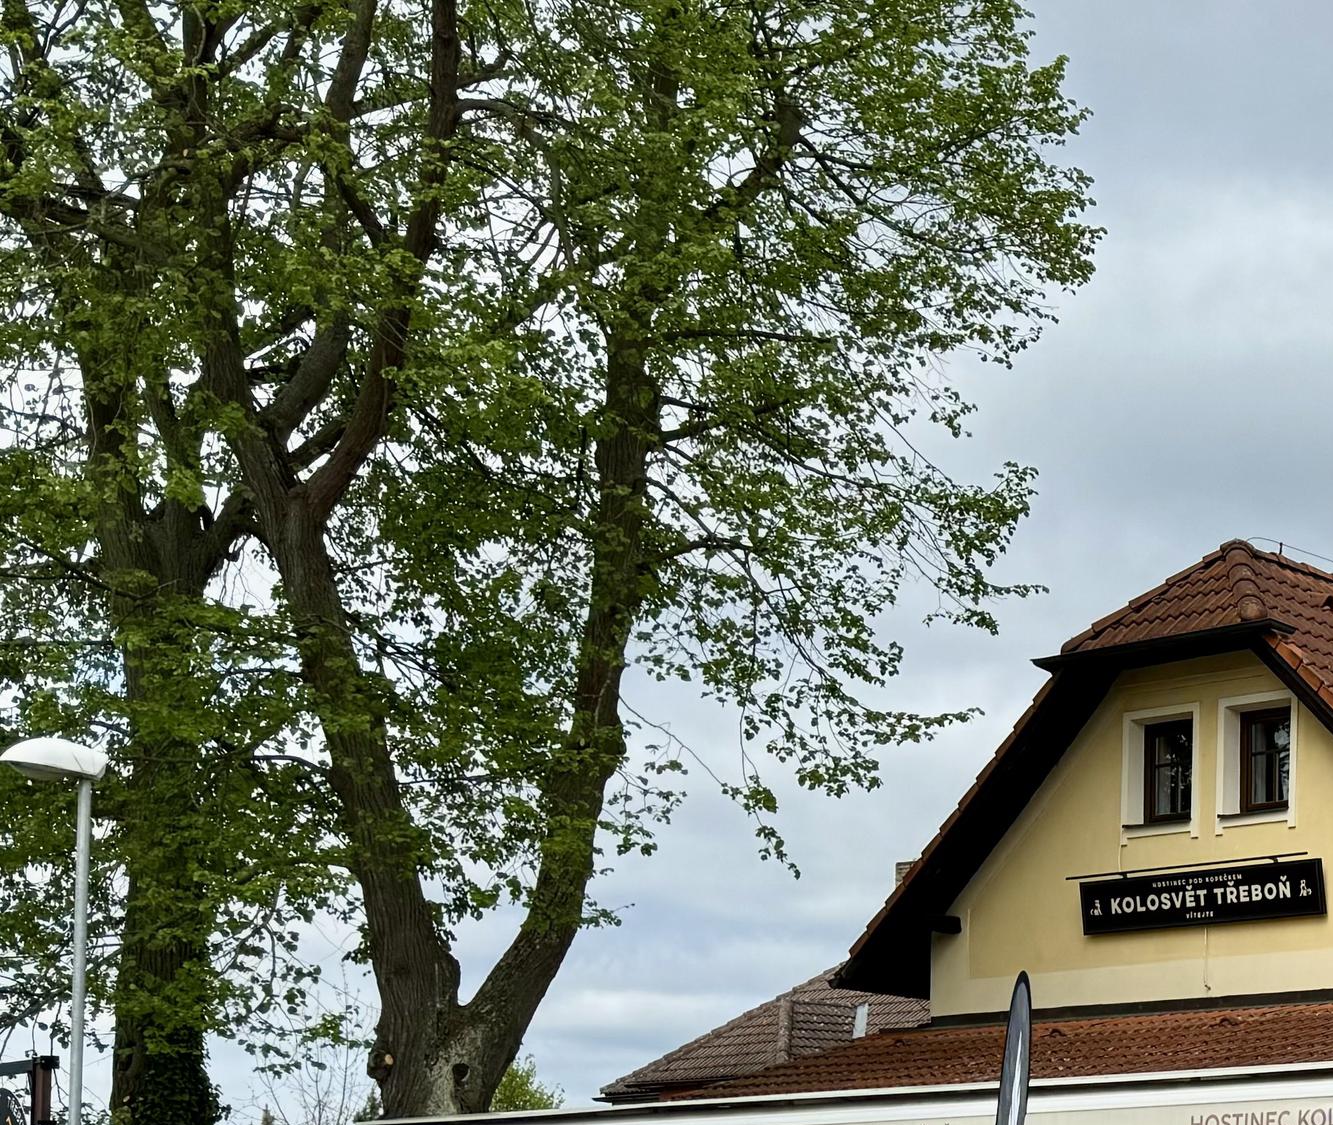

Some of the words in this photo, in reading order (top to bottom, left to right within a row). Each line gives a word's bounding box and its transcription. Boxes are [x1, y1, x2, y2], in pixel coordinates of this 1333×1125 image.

[1152, 879, 1186, 888] HOSTINEC
[1205, 873, 1242, 883] KOPEČKEM
[1110, 885, 1207, 915] KOLOSVĚT
[1213, 875, 1291, 905] TŘEBOŇ
[1186, 911, 1214, 919] VÍTEJTE
